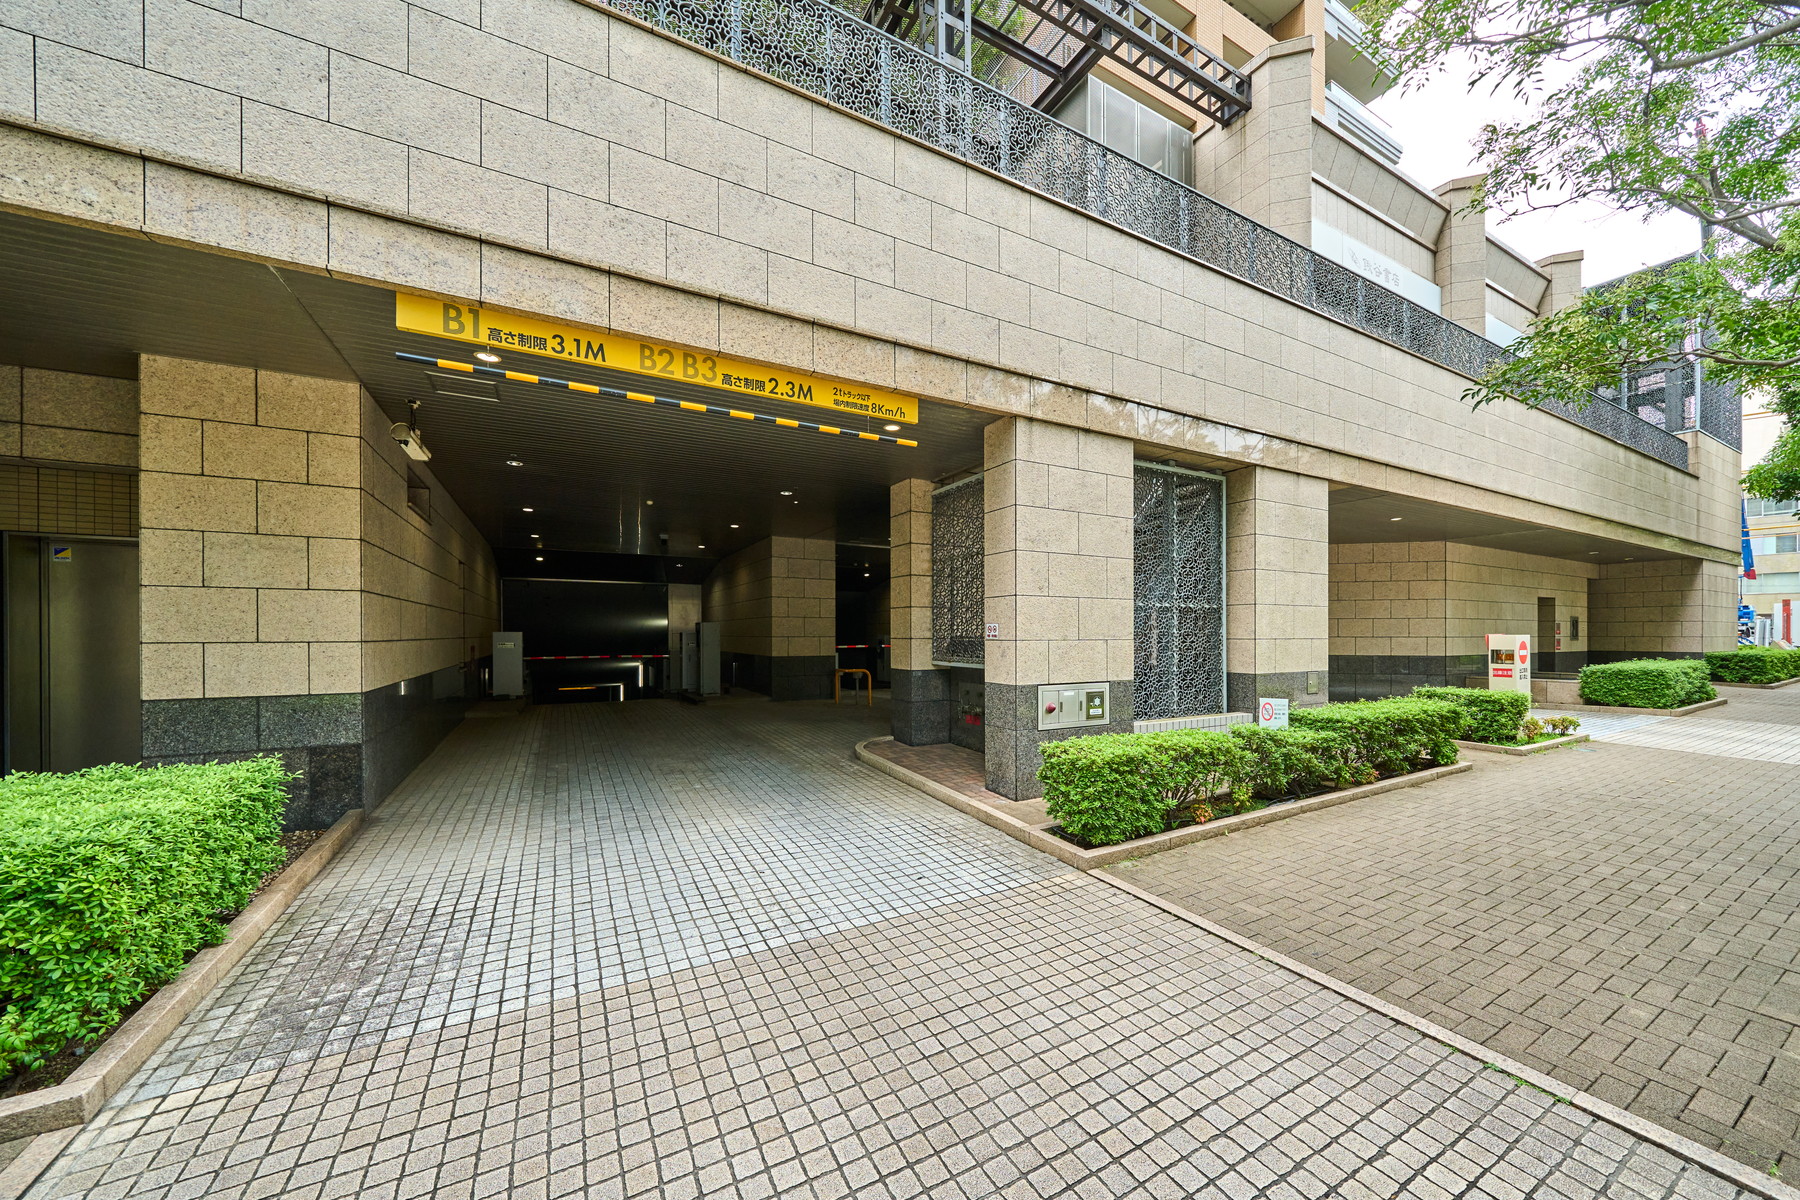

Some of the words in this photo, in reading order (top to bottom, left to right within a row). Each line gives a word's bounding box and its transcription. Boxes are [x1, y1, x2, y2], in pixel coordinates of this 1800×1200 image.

[443, 303, 480, 339] B1
[488, 327, 547, 351] 高さ制限
[551, 334, 606, 362] 3.1M
[639, 343, 675, 376] B2
[682, 352, 718, 382] B3
[721, 373, 766, 393] 高さ制限
[768, 377, 814, 402] 2.3M
[871, 402, 906, 419] 8Km/h
